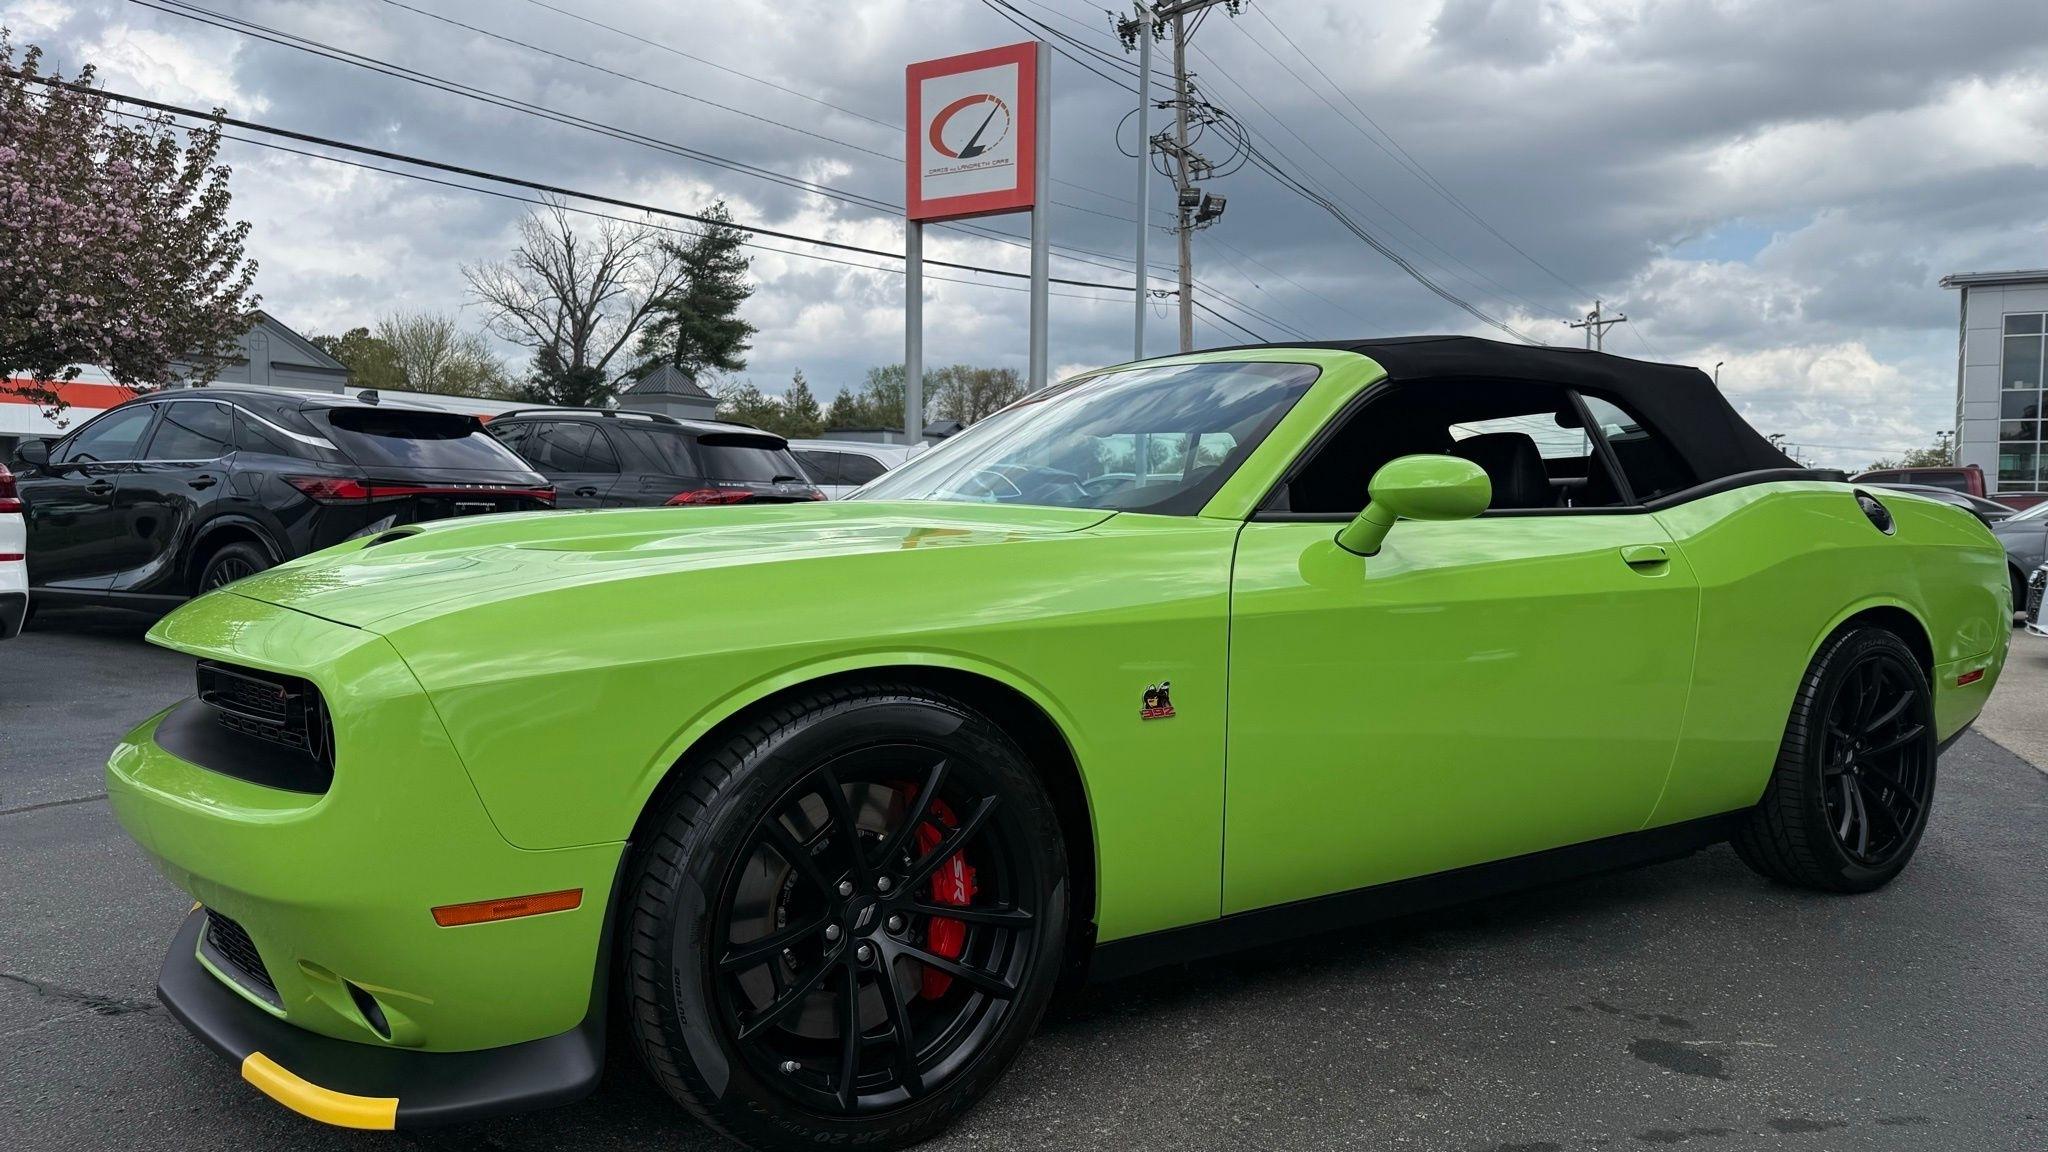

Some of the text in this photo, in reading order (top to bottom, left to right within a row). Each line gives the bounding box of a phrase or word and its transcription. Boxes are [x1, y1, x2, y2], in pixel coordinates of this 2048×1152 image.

[992, 158, 1010, 166] CARS
[1141, 706, 1176, 719] 392
[674, 966, 688, 1025] OUTSIDE
